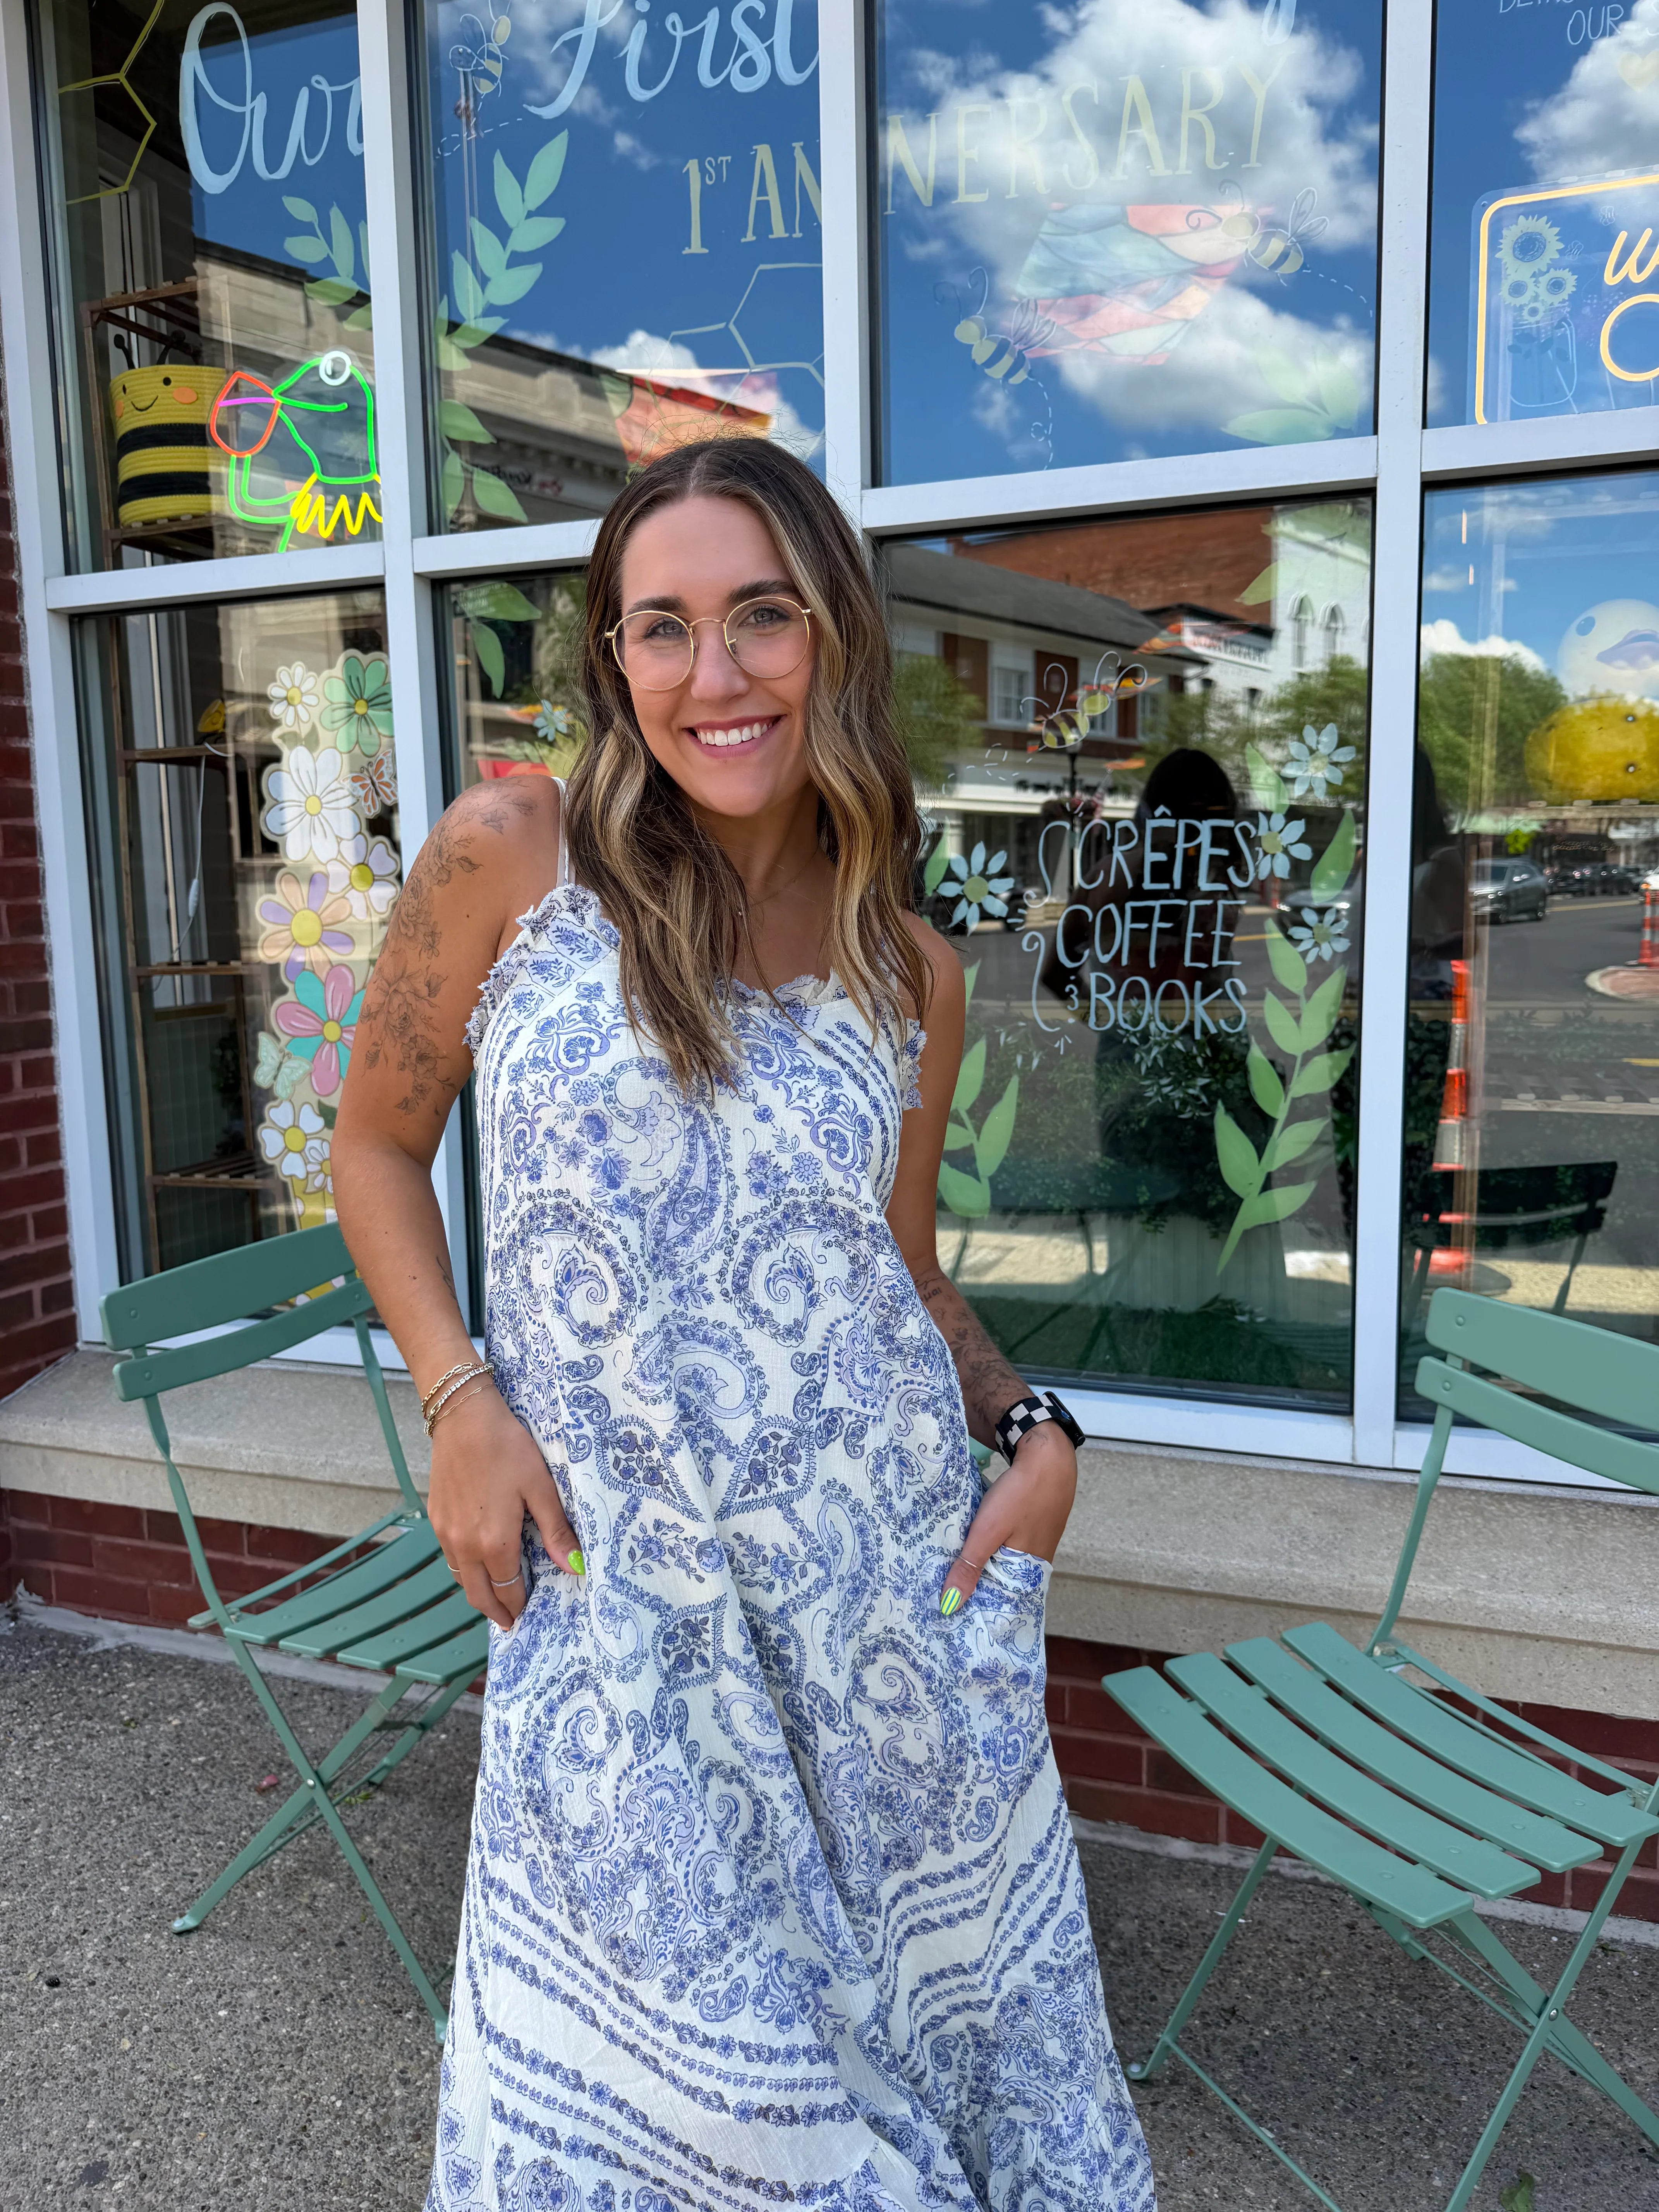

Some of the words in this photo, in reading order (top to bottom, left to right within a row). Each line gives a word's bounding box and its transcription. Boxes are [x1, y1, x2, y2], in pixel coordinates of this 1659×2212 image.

[1567, 4, 1624, 45] OUR
[1076, 804, 1257, 891] CRÊPES
[1056, 900, 1247, 969] COFFEE
[1088, 972, 1247, 1040] BOOKS
